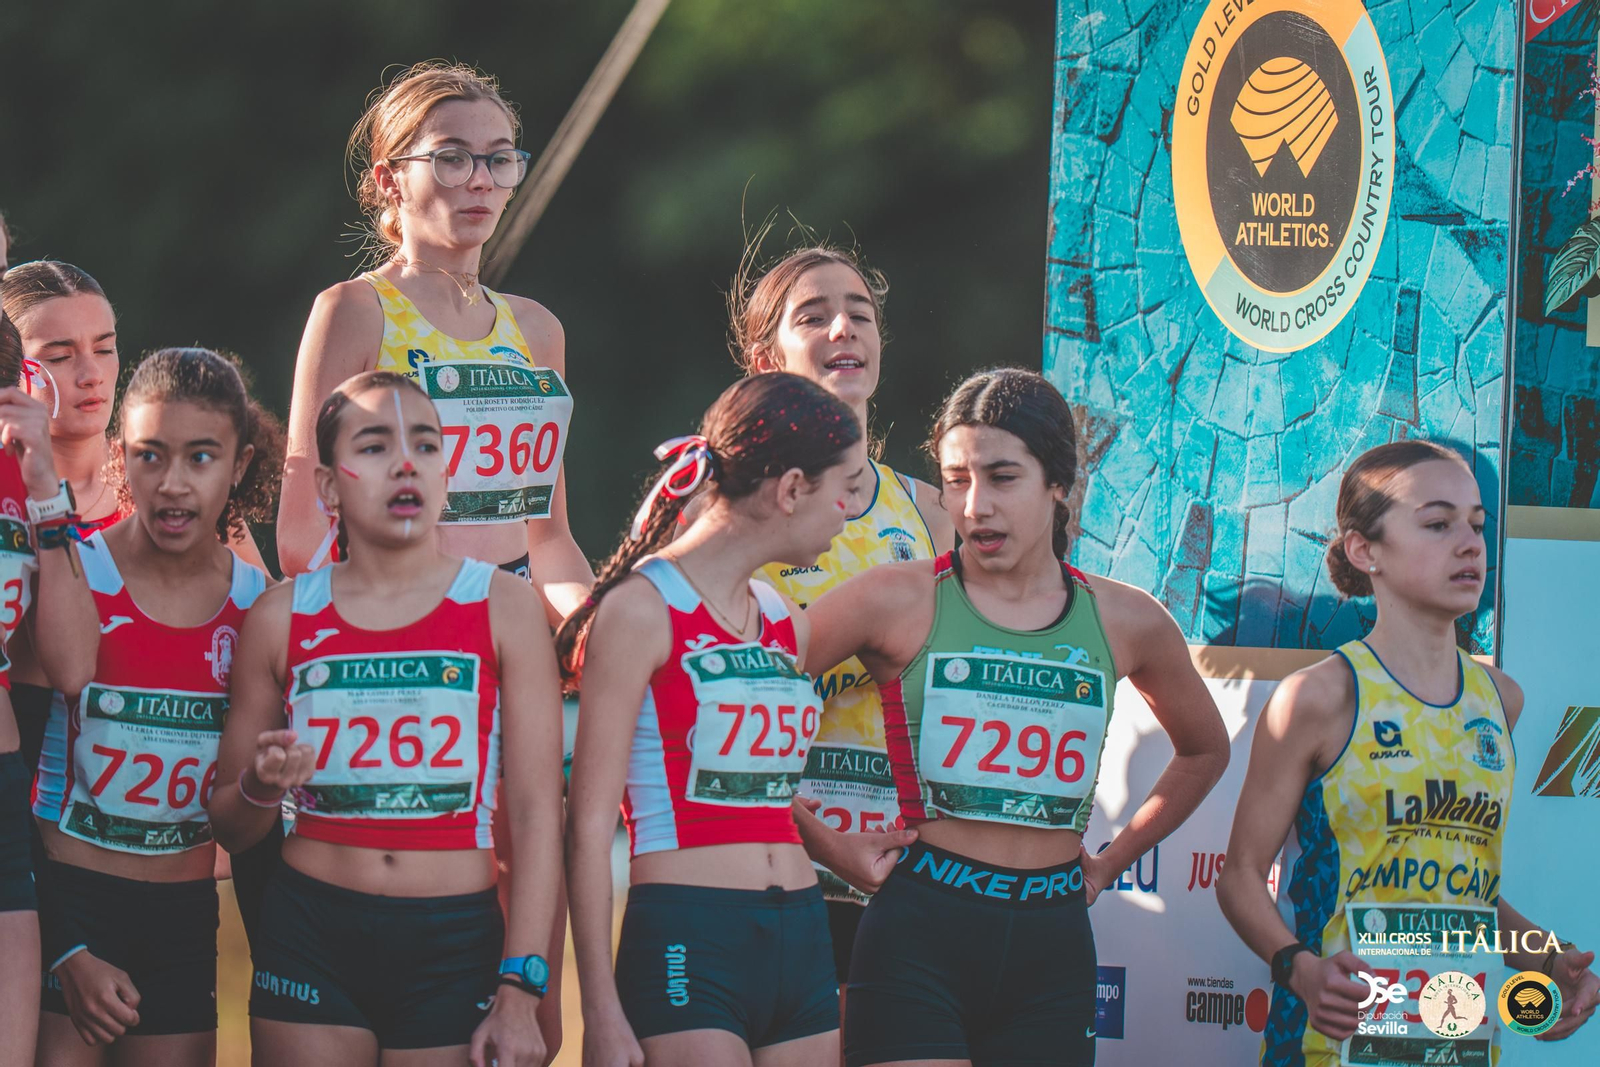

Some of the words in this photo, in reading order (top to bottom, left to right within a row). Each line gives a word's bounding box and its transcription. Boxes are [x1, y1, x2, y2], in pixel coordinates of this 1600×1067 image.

[1187, 36, 1216, 116] GOLD
[1214, 0, 1254, 38] LEV
[1363, 65, 1384, 145] TOUR
[1251, 192, 1315, 217] WORLD
[1344, 151, 1384, 279] COUNTRY
[1235, 222, 1330, 248] ATHLETICS
[1235, 292, 1291, 333] WORLD
[1294, 275, 1346, 330] CROSS
[469, 365, 533, 388] ITÁLICA
[484, 398, 509, 406] ROSETY
[507, 404, 528, 412] OLIMPO
[442, 421, 560, 478] 7360
[3, 578, 24, 631] 3
[342, 657, 430, 679] ITÁLICA
[981, 661, 1065, 690] ITÁLICA
[812, 671, 874, 701] MPO
[976, 691, 1010, 702] DANIELA
[137, 694, 214, 721] ITÁLICA
[120, 723, 154, 736] VALERIA
[307, 714, 464, 770] 7262
[718, 703, 817, 758] 7259
[820, 748, 892, 777] ITÁLICA
[941, 715, 1088, 784] 7296
[1369, 749, 1413, 761] austral
[1445, 832, 1460, 842] LA
[912, 851, 1019, 900] NIKE
[1019, 865, 1084, 901] PRO
[1187, 851, 1226, 893] JUS
[1398, 907, 1467, 932] ITÁLICA
[255, 970, 320, 1005] CURTIUS
[664, 943, 690, 1007] CURTIUS
[1187, 976, 1234, 990] www.tiendas
[1096, 983, 1120, 1003] mpo
